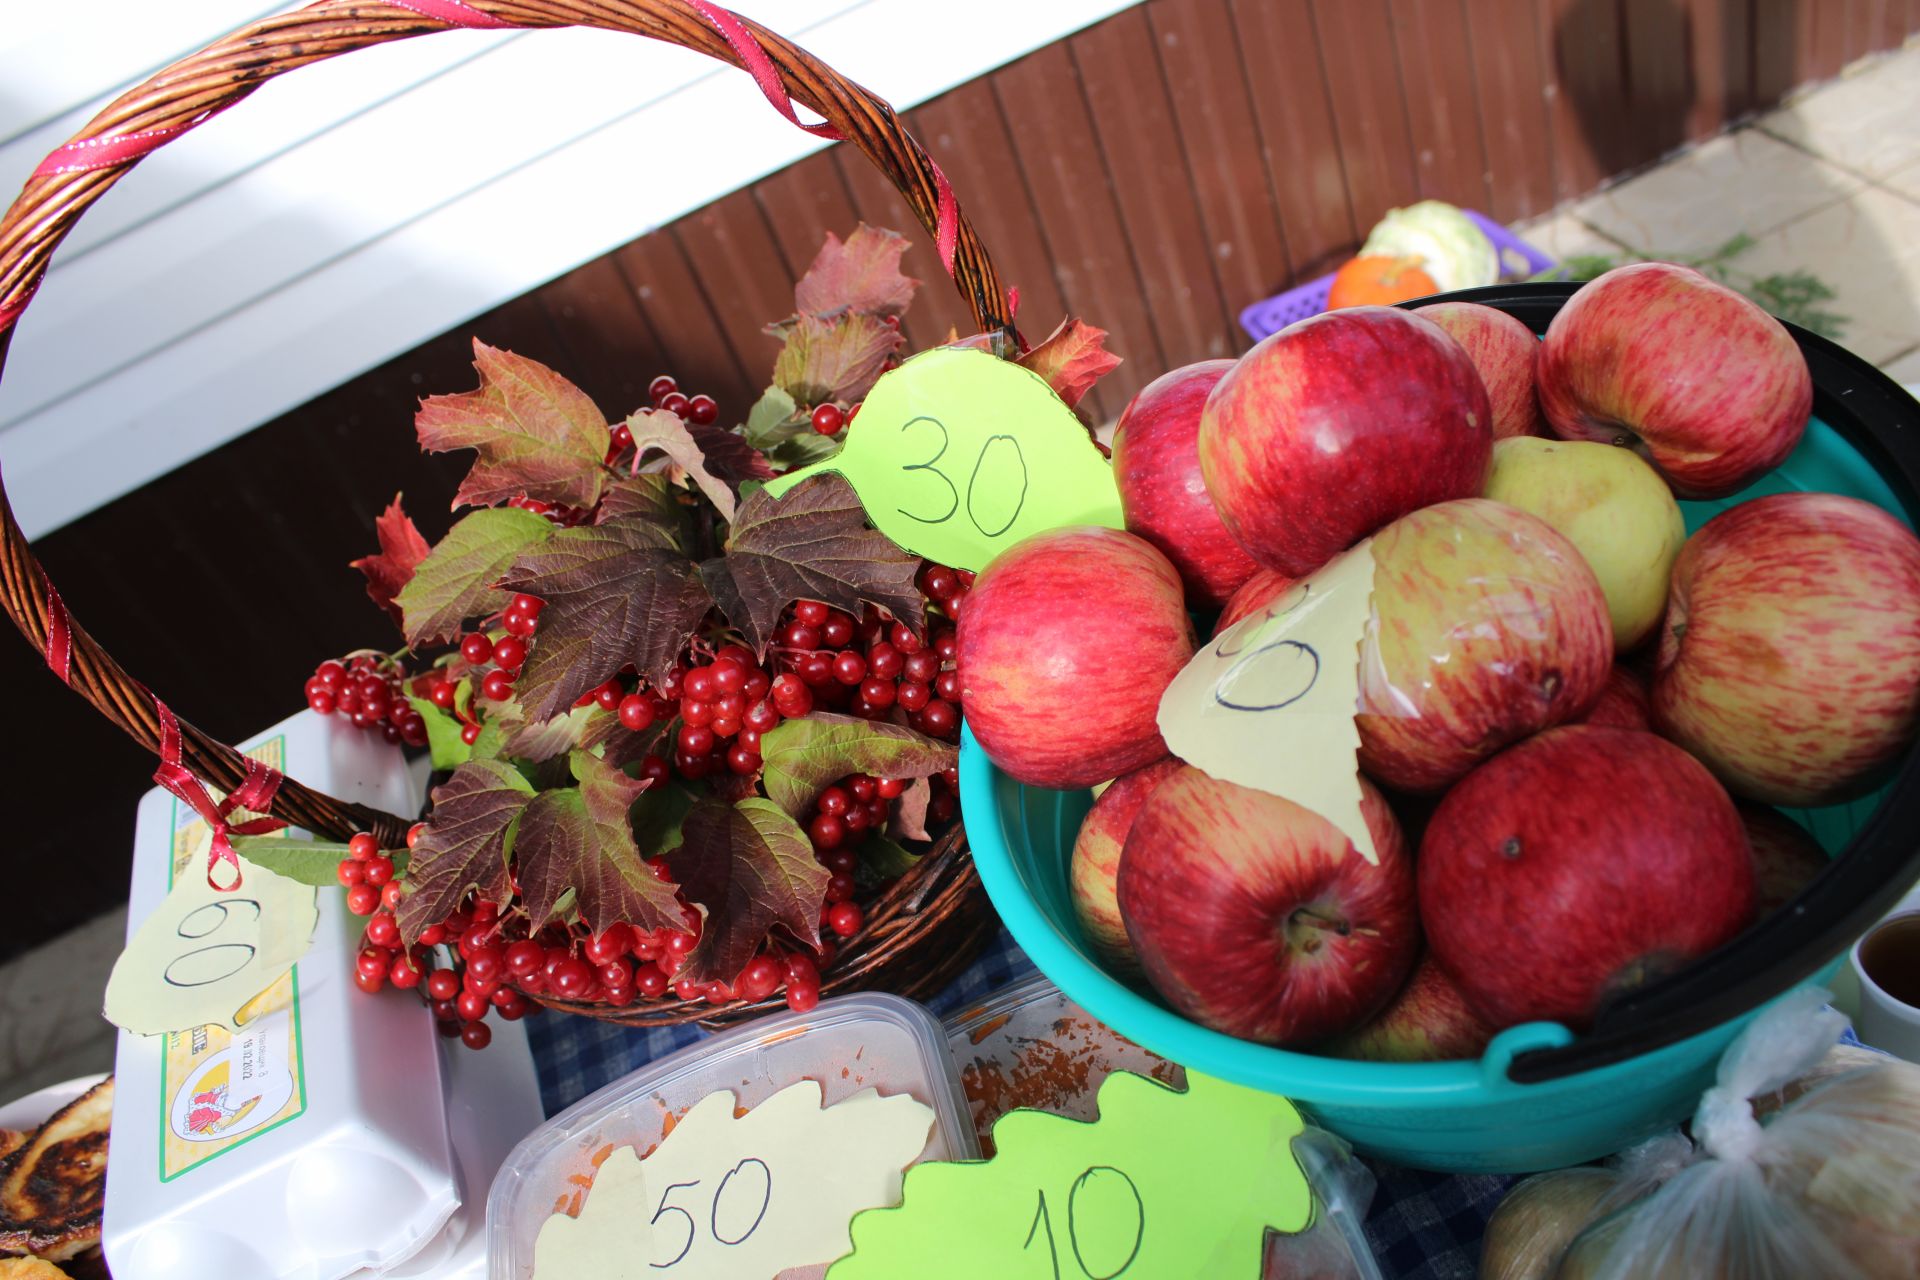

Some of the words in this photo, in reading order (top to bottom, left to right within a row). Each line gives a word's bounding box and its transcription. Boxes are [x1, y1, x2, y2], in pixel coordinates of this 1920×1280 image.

[898, 416, 1028, 538] 30
[164, 898, 261, 987] 60
[649, 1157, 771, 1268] 50
[1023, 1166, 1145, 1280] 10
